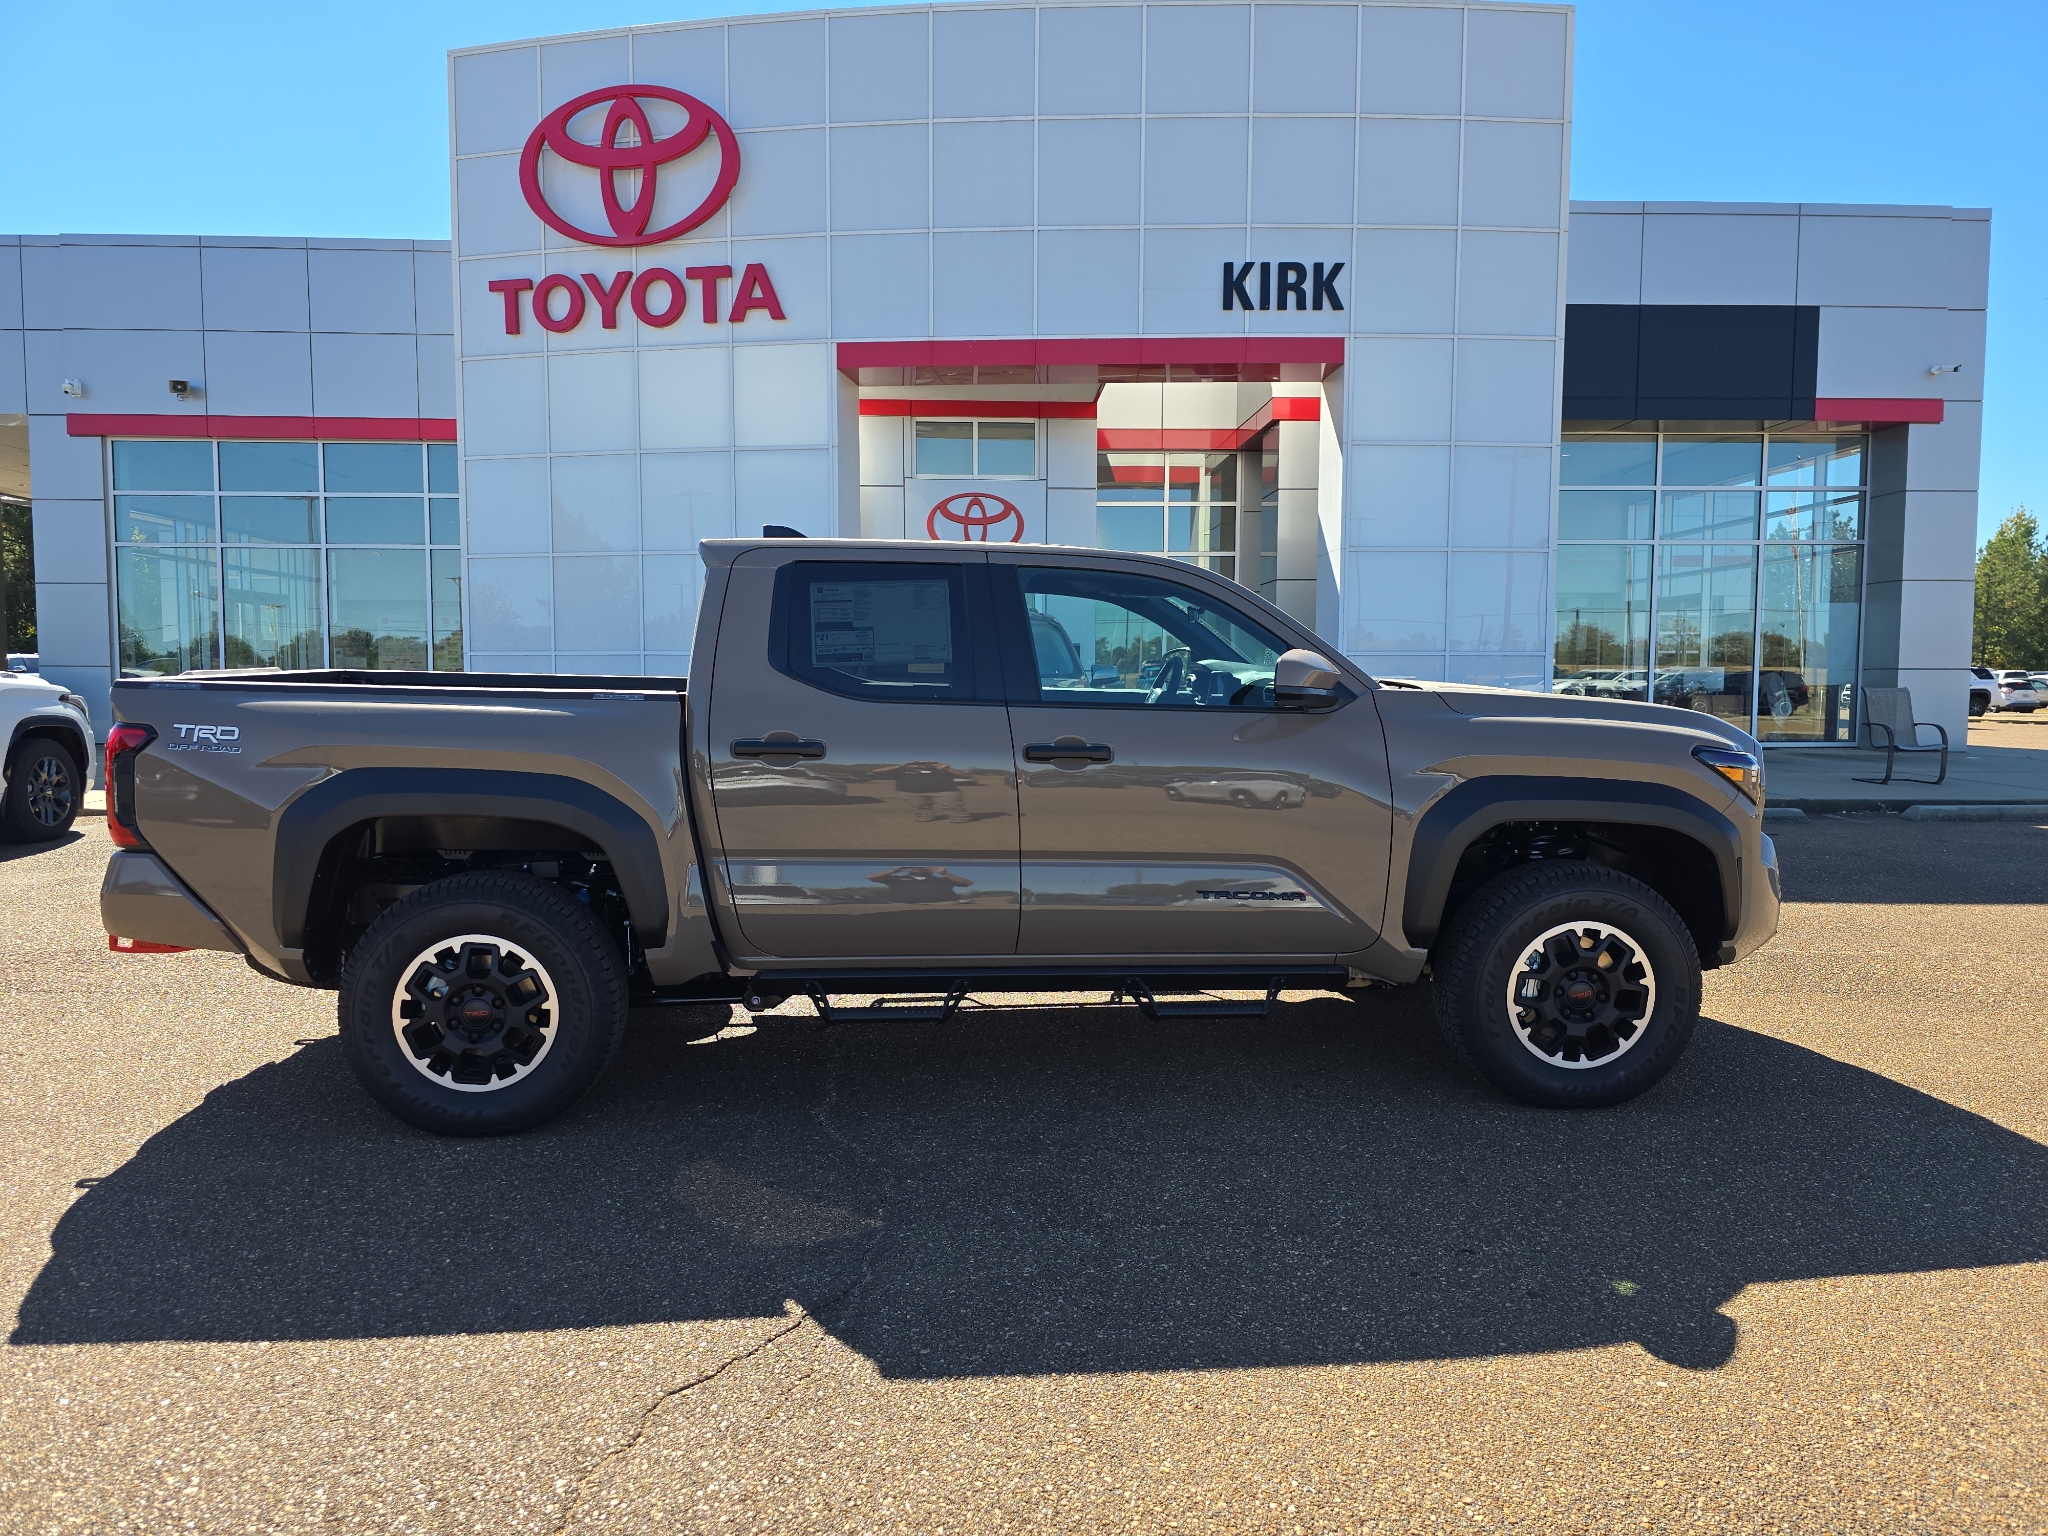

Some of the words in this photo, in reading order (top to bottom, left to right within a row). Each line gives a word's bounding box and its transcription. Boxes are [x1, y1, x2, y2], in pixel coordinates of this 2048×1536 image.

[1222, 261, 1345, 311] KIRK
[489, 263, 786, 336] TOYOTA
[173, 723, 240, 744] TRD
[168, 743, 199, 751] OFF
[201, 745, 242, 754] ROAD
[1196, 889, 1307, 901] TACOMA
[1569, 989, 1593, 1000] TRD
[463, 1009, 489, 1018] TRD
